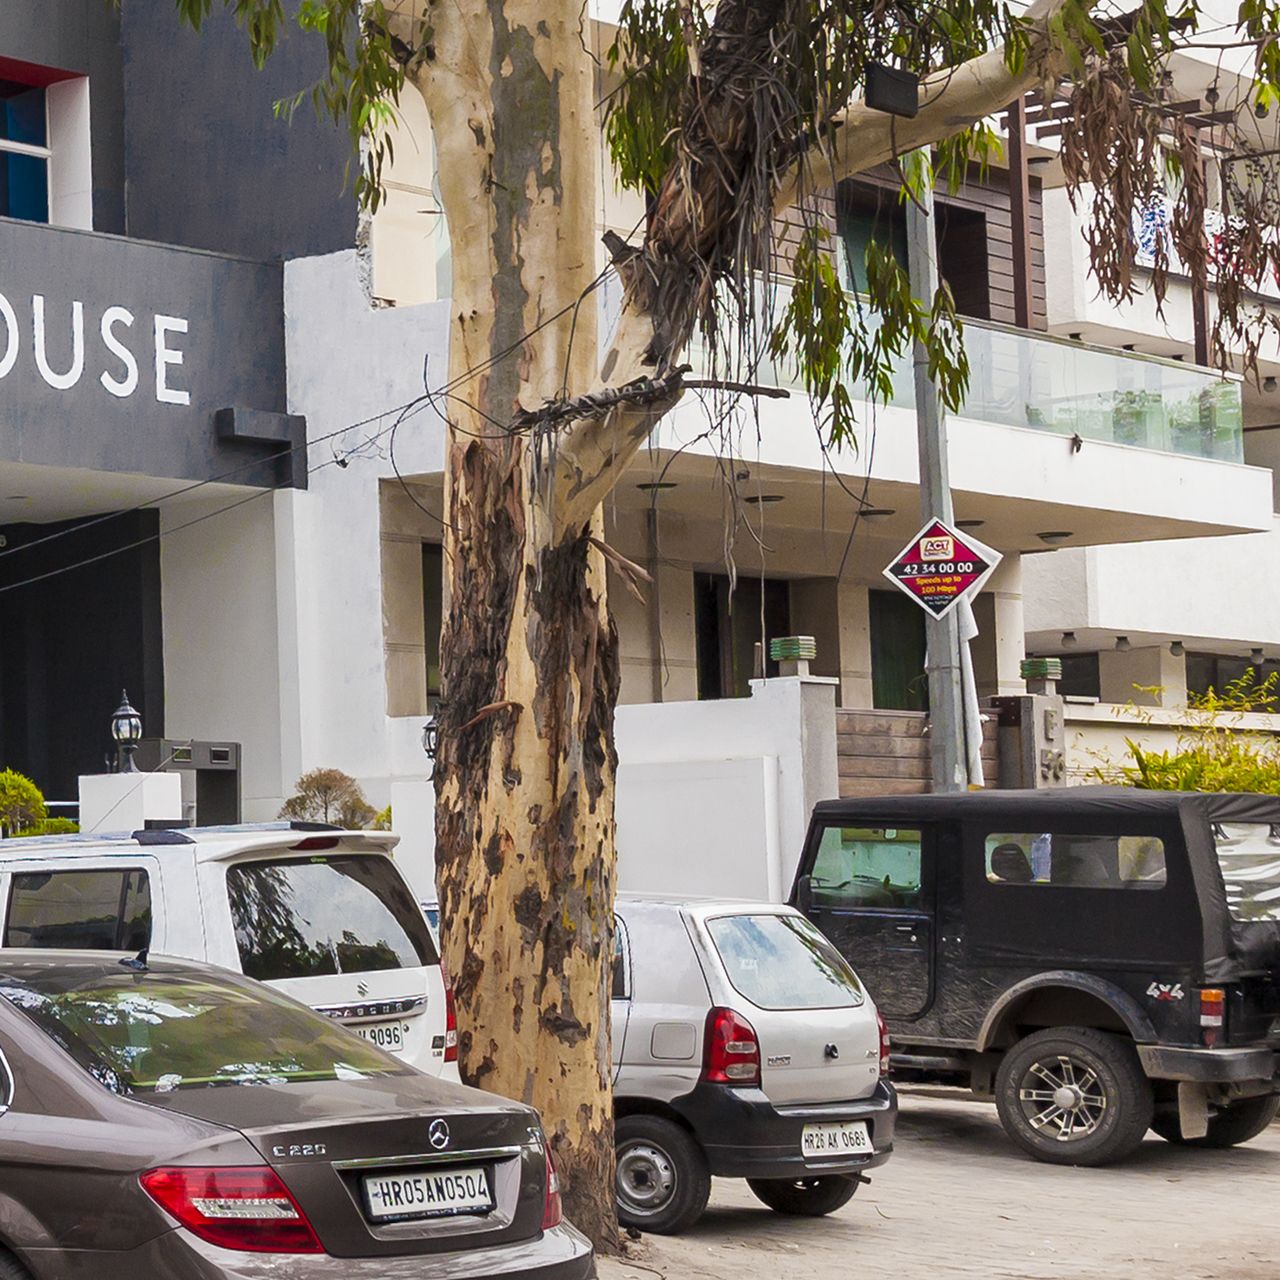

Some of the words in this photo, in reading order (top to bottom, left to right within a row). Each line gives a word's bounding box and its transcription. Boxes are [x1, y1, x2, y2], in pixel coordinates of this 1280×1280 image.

[925, 541, 949, 550] ACT
[904, 565, 918, 574] 42
[922, 564, 936, 573] 34
[939, 563, 954, 573] 00
[957, 562, 973, 572] 00
[370, 1026, 400, 1046] 9096
[273, 1146, 285, 1157] C
[379, 1174, 489, 1207] HR05AN0504
